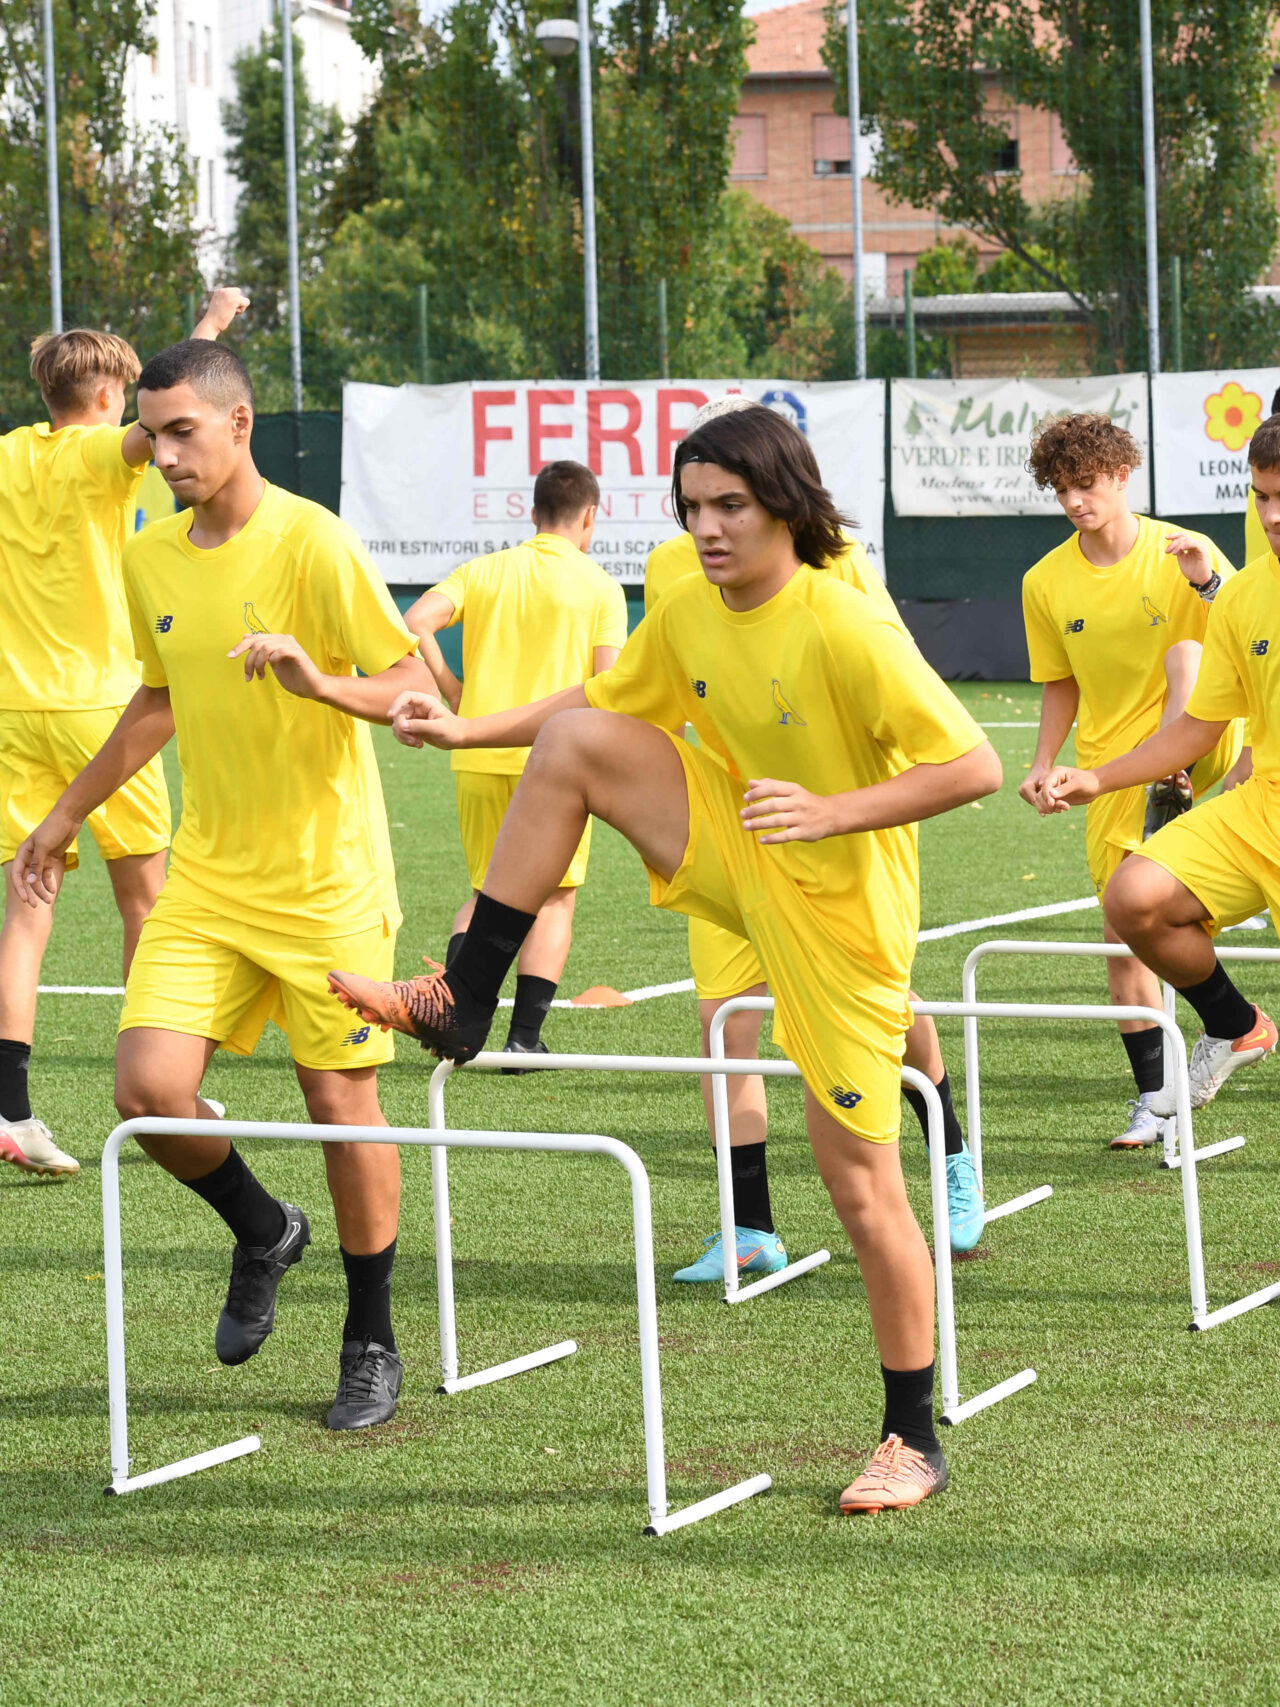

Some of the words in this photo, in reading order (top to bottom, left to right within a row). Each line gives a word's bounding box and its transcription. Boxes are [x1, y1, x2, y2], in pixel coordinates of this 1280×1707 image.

[900, 447, 970, 467] VERDE
[978, 447, 990, 467] E
[400, 540, 478, 555] ESTINTORI
